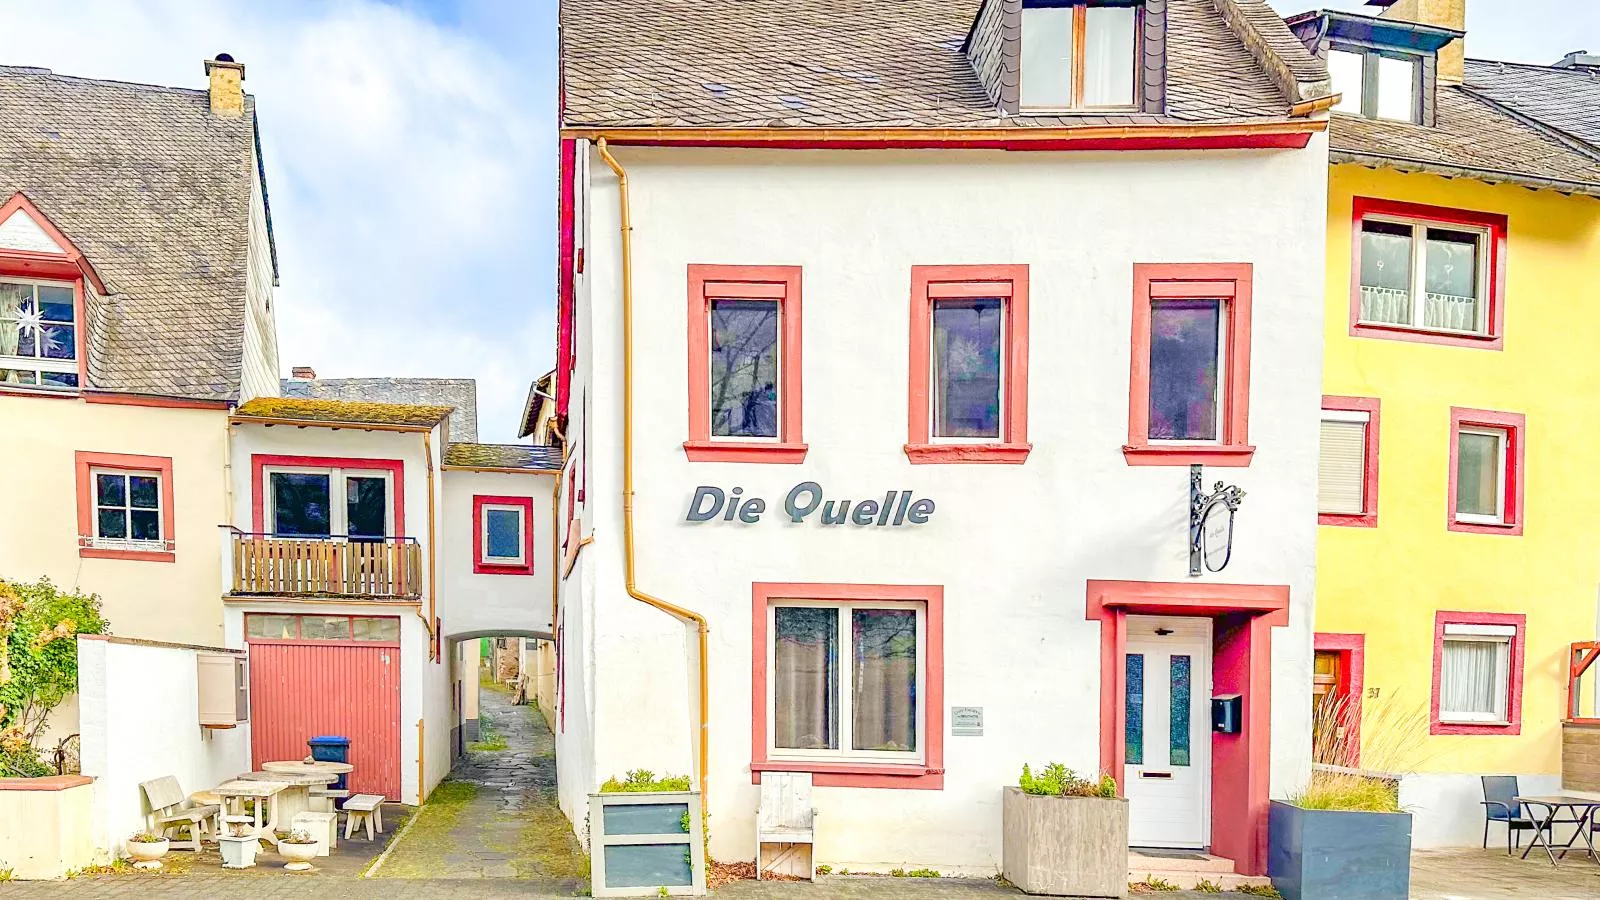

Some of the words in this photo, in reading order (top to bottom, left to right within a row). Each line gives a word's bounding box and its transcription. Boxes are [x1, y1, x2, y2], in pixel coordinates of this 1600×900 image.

[686, 485, 766, 524] Die
[784, 481, 936, 526] Quelle
[1367, 687, 1380, 699] 37
